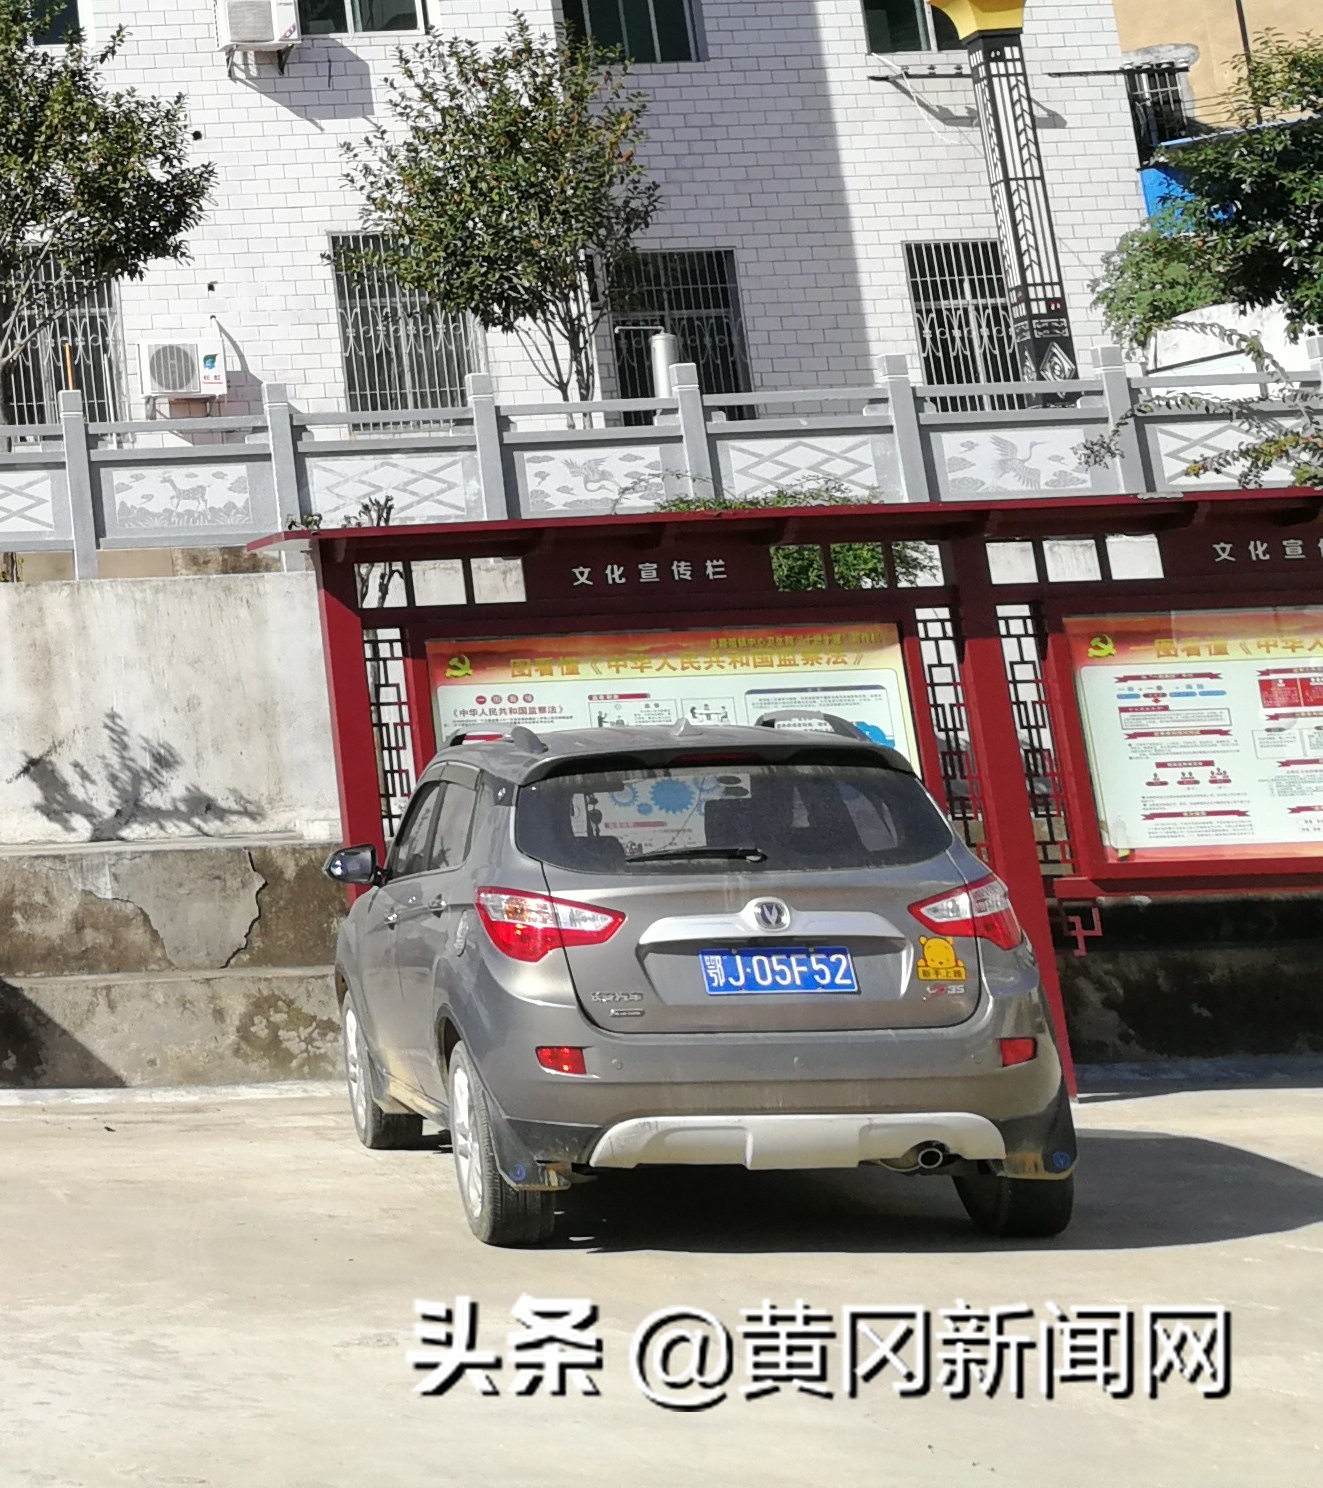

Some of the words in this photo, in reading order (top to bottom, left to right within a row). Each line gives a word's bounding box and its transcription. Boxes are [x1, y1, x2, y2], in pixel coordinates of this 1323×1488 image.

[571, 558, 728, 586] 文化宣传栏
